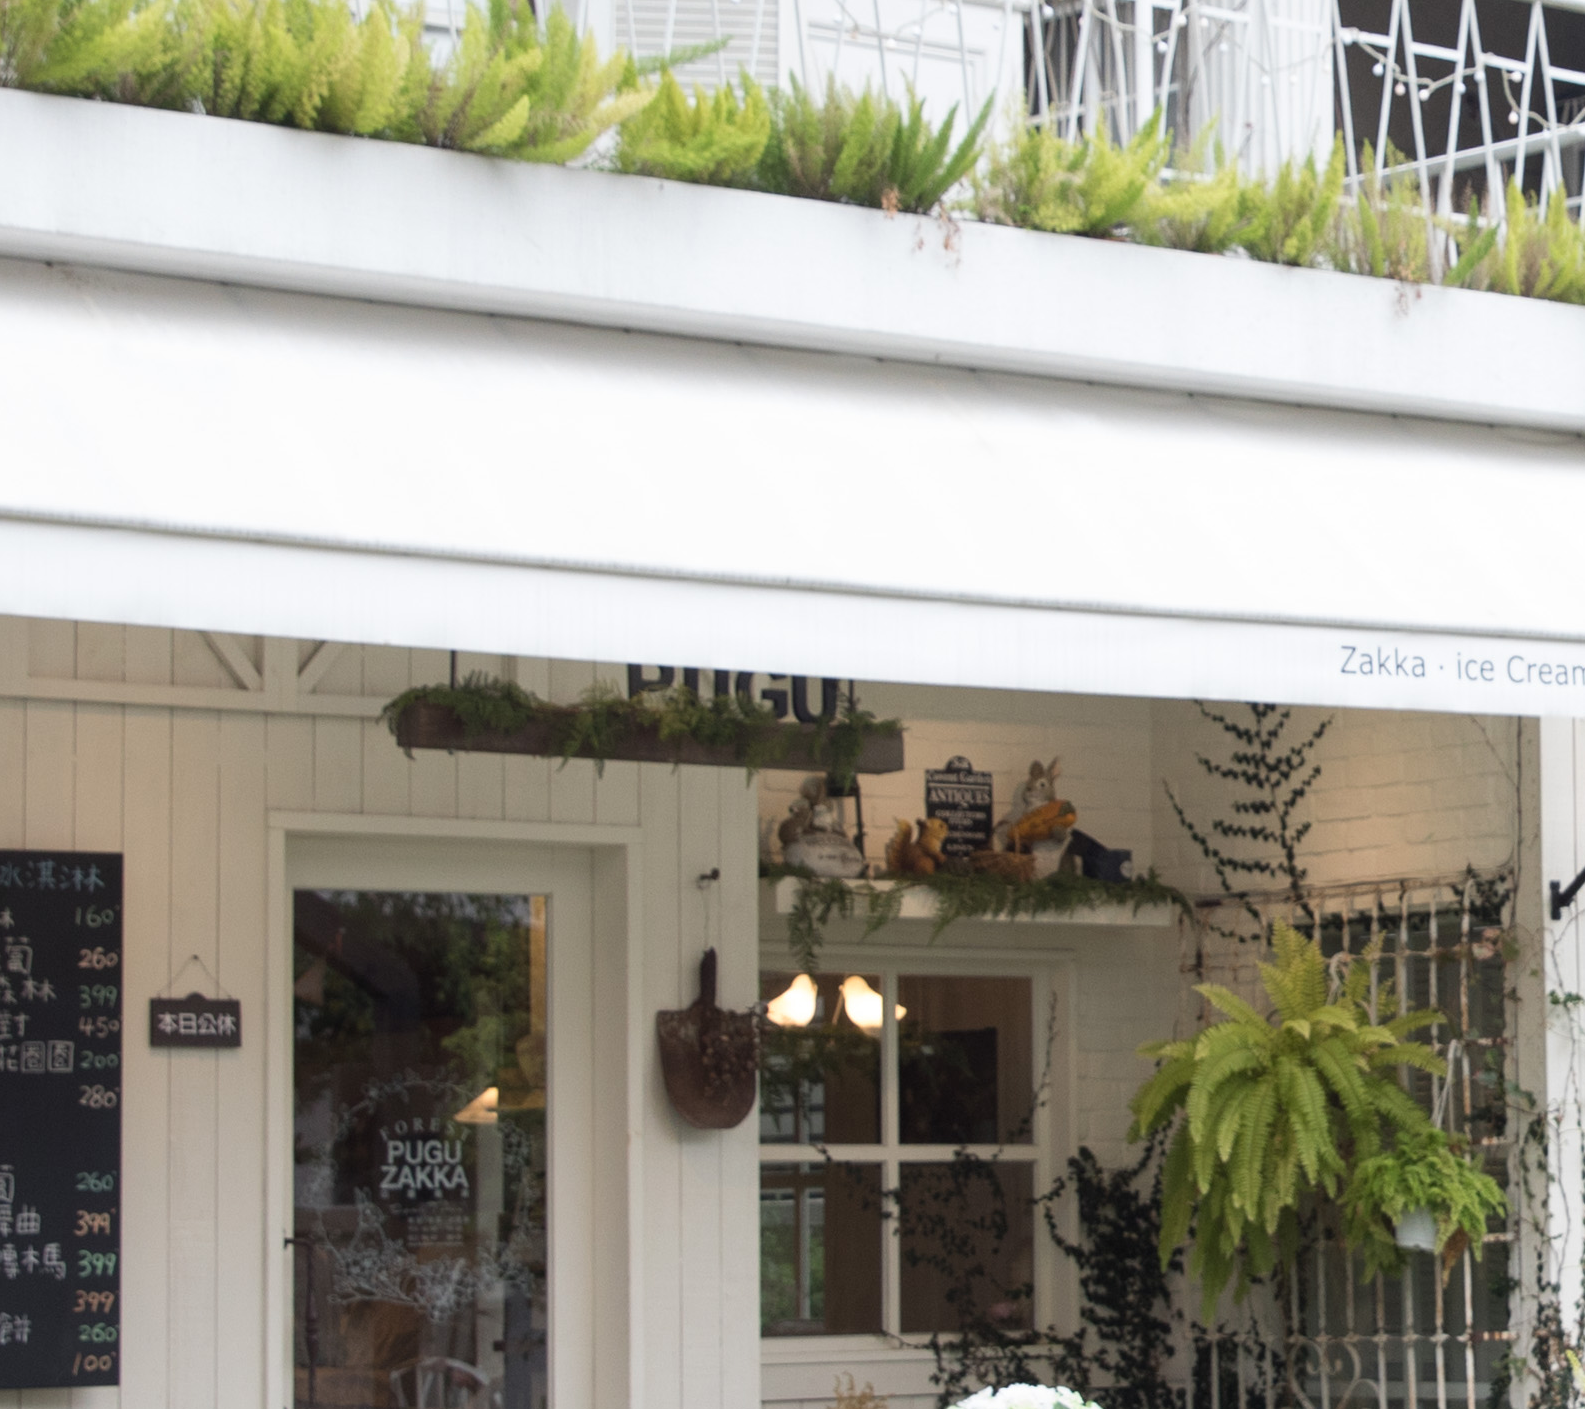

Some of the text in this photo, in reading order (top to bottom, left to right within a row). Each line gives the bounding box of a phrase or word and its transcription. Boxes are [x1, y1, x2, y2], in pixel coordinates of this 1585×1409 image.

[1340, 645, 1426, 678] Zakka
[1457, 651, 1495, 682] ice
[75, 904, 115, 928] 160
[78, 946, 118, 970] 260
[78, 984, 118, 1009] 399
[78, 1015, 119, 1039] 450
[157, 1011, 237, 1037] 本日公休
[79, 1049, 118, 1070] 200
[78, 1084, 117, 1110] 280
[387, 1139, 463, 1165] PUGU
[75, 1171, 115, 1192] 260
[380, 1165, 470, 1190] ZAKKA
[74, 1209, 112, 1237] 399
[77, 1249, 117, 1278] 399
[72, 1289, 116, 1314] 399
[78, 1322, 117, 1344] 260
[72, 1352, 114, 1376] 100
